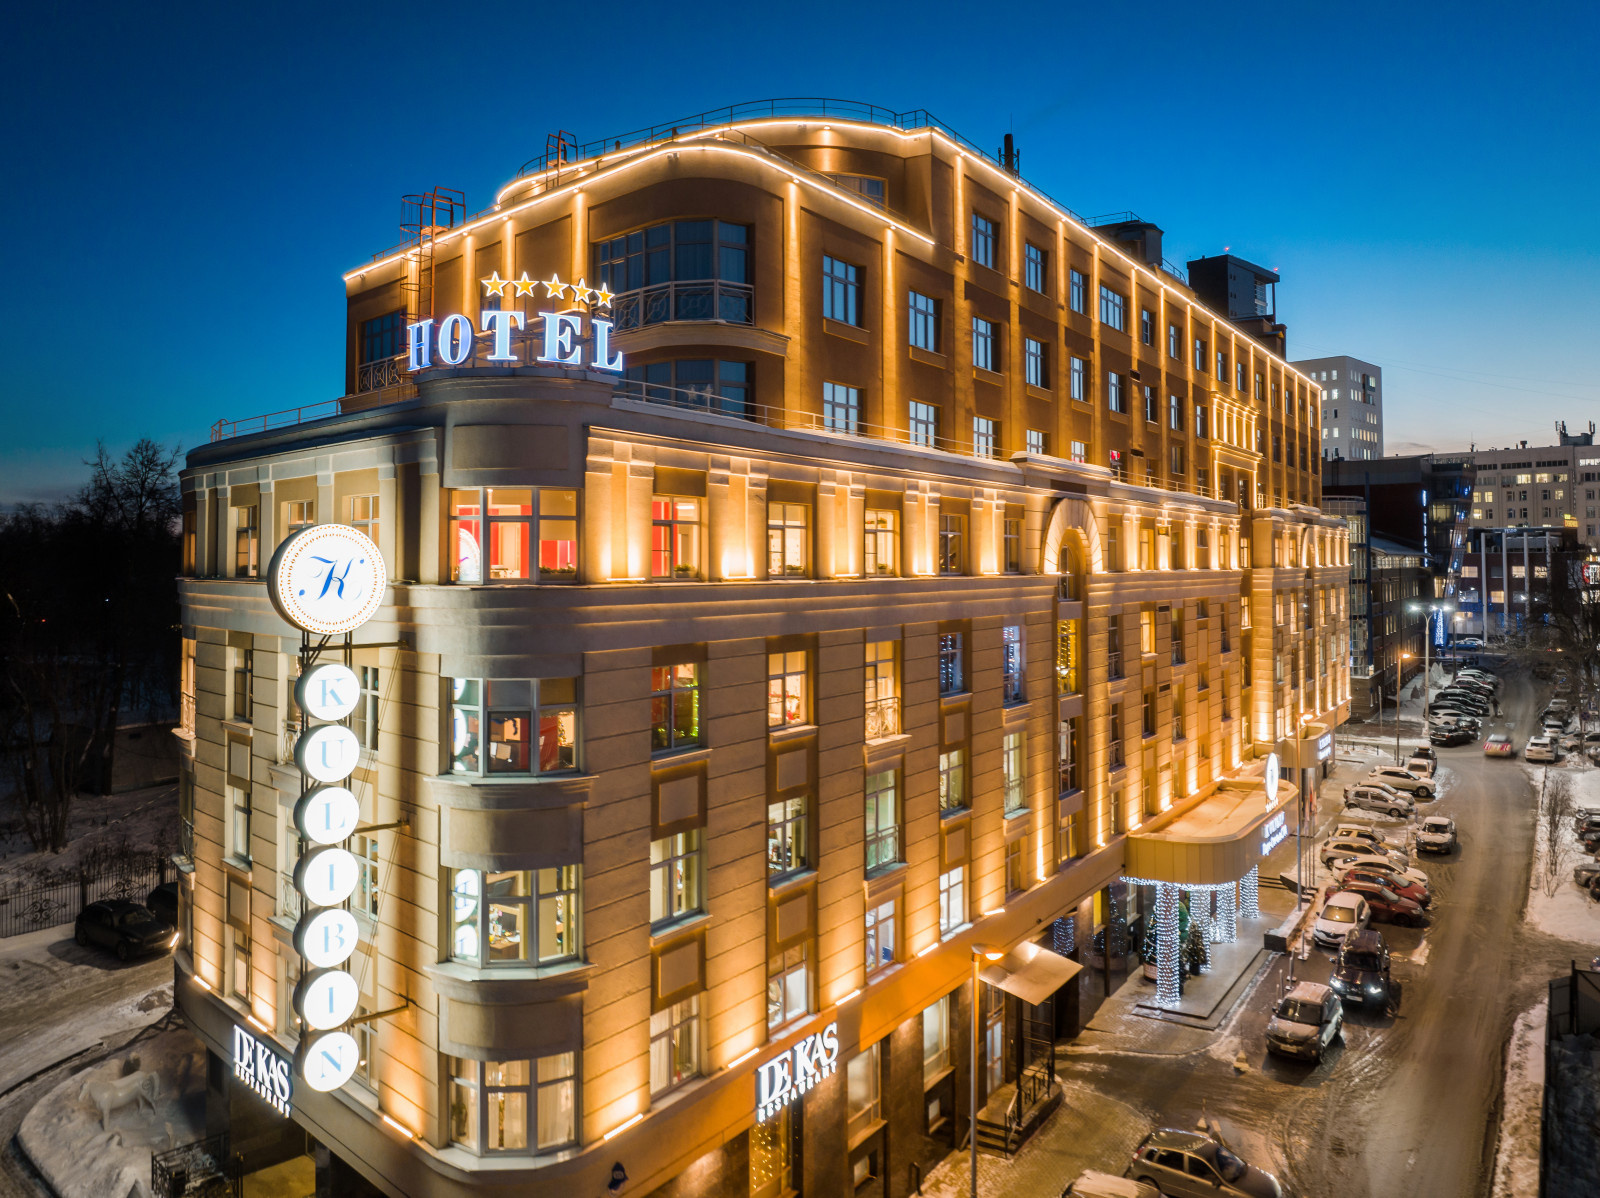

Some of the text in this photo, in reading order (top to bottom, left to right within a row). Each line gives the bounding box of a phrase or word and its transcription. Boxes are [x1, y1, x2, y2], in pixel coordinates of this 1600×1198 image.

[406, 310, 623, 371] HOTEL
[298, 555, 365, 601] K
[314, 675, 351, 1081] KULIBIN
[234, 1063, 291, 1119] RESTAURANT
[757, 1060, 837, 1123] RESTAURANT
